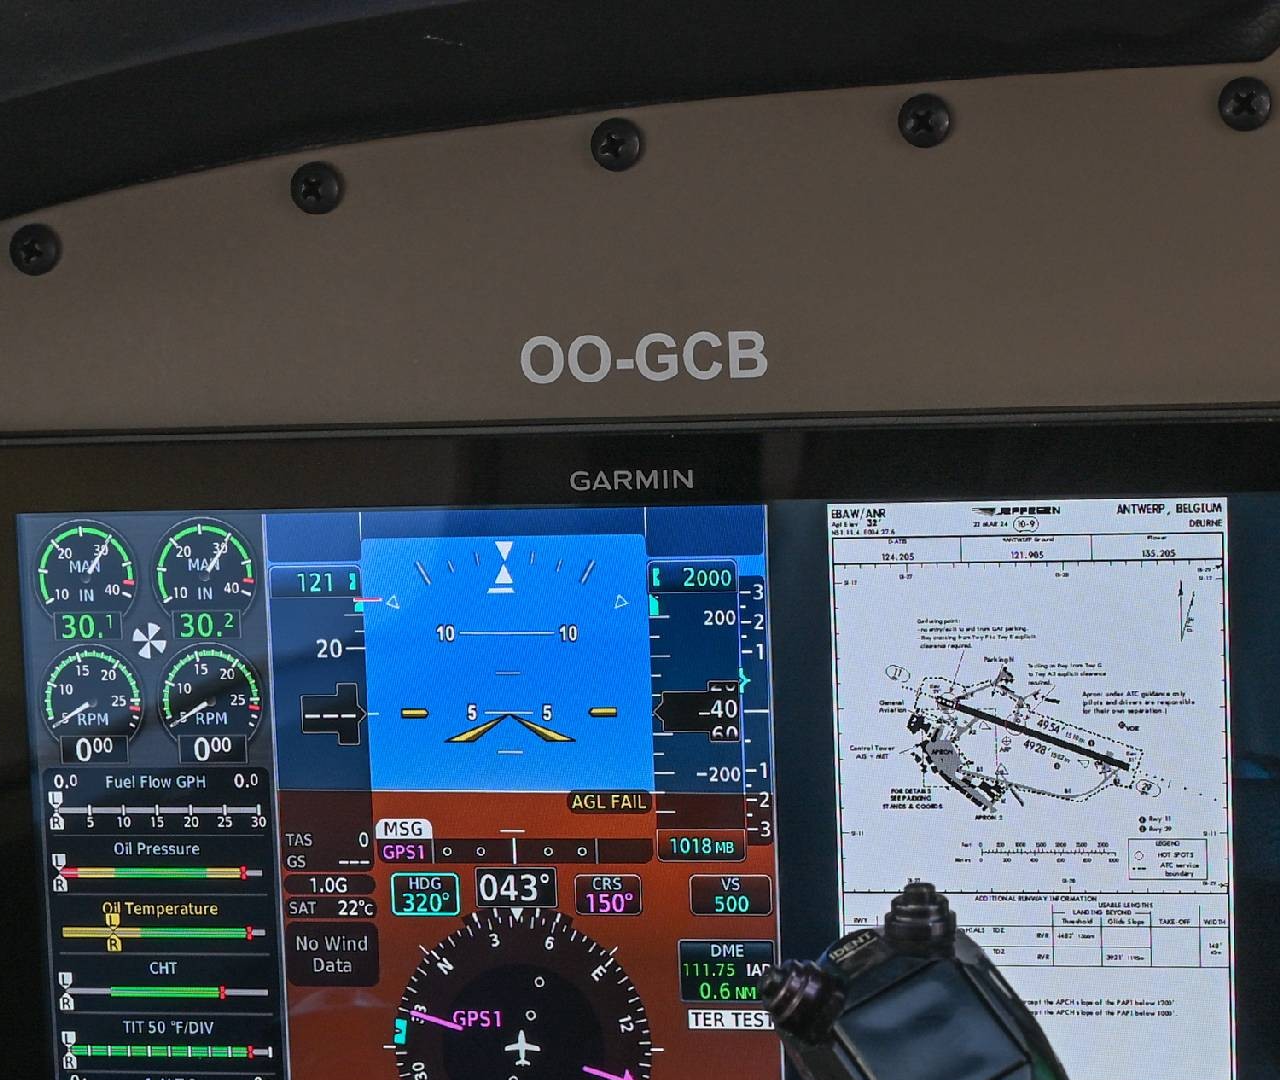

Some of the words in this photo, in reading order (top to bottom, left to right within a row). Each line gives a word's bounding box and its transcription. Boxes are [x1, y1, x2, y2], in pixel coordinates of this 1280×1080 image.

[520, 331, 768, 384] OO-GCB
[570, 469, 694, 491] GARMIN
[1175, 503, 1223, 514] BELGIUM
[105, 775, 135, 789] Fuel
[140, 775, 172, 789] Flow
[176, 775, 206, 789] GPH
[572, 795, 606, 809] AGL
[611, 795, 646, 809] FAIL
[384, 822, 422, 836] MSG
[113, 842, 134, 855] Oil
[137, 842, 200, 856] Pressure
[670, 838, 712, 854] 1018
[716, 841, 734, 854] MB
[409, 877, 442, 890] HDG
[479, 872, 549, 902] 043°
[592, 877, 622, 890] CRS
[721, 878, 740, 890] VS
[402, 892, 450, 912] 320°
[586, 892, 634, 913] 150°
[715, 896, 749, 913] 500
[102, 902, 121, 914] Oil
[124, 902, 219, 918] Temperature
[296, 936, 319, 951] No
[325, 935, 368, 952] Wind
[711, 944, 745, 958] DME
[149, 962, 178, 975] CHT
[313, 957, 352, 973] Data
